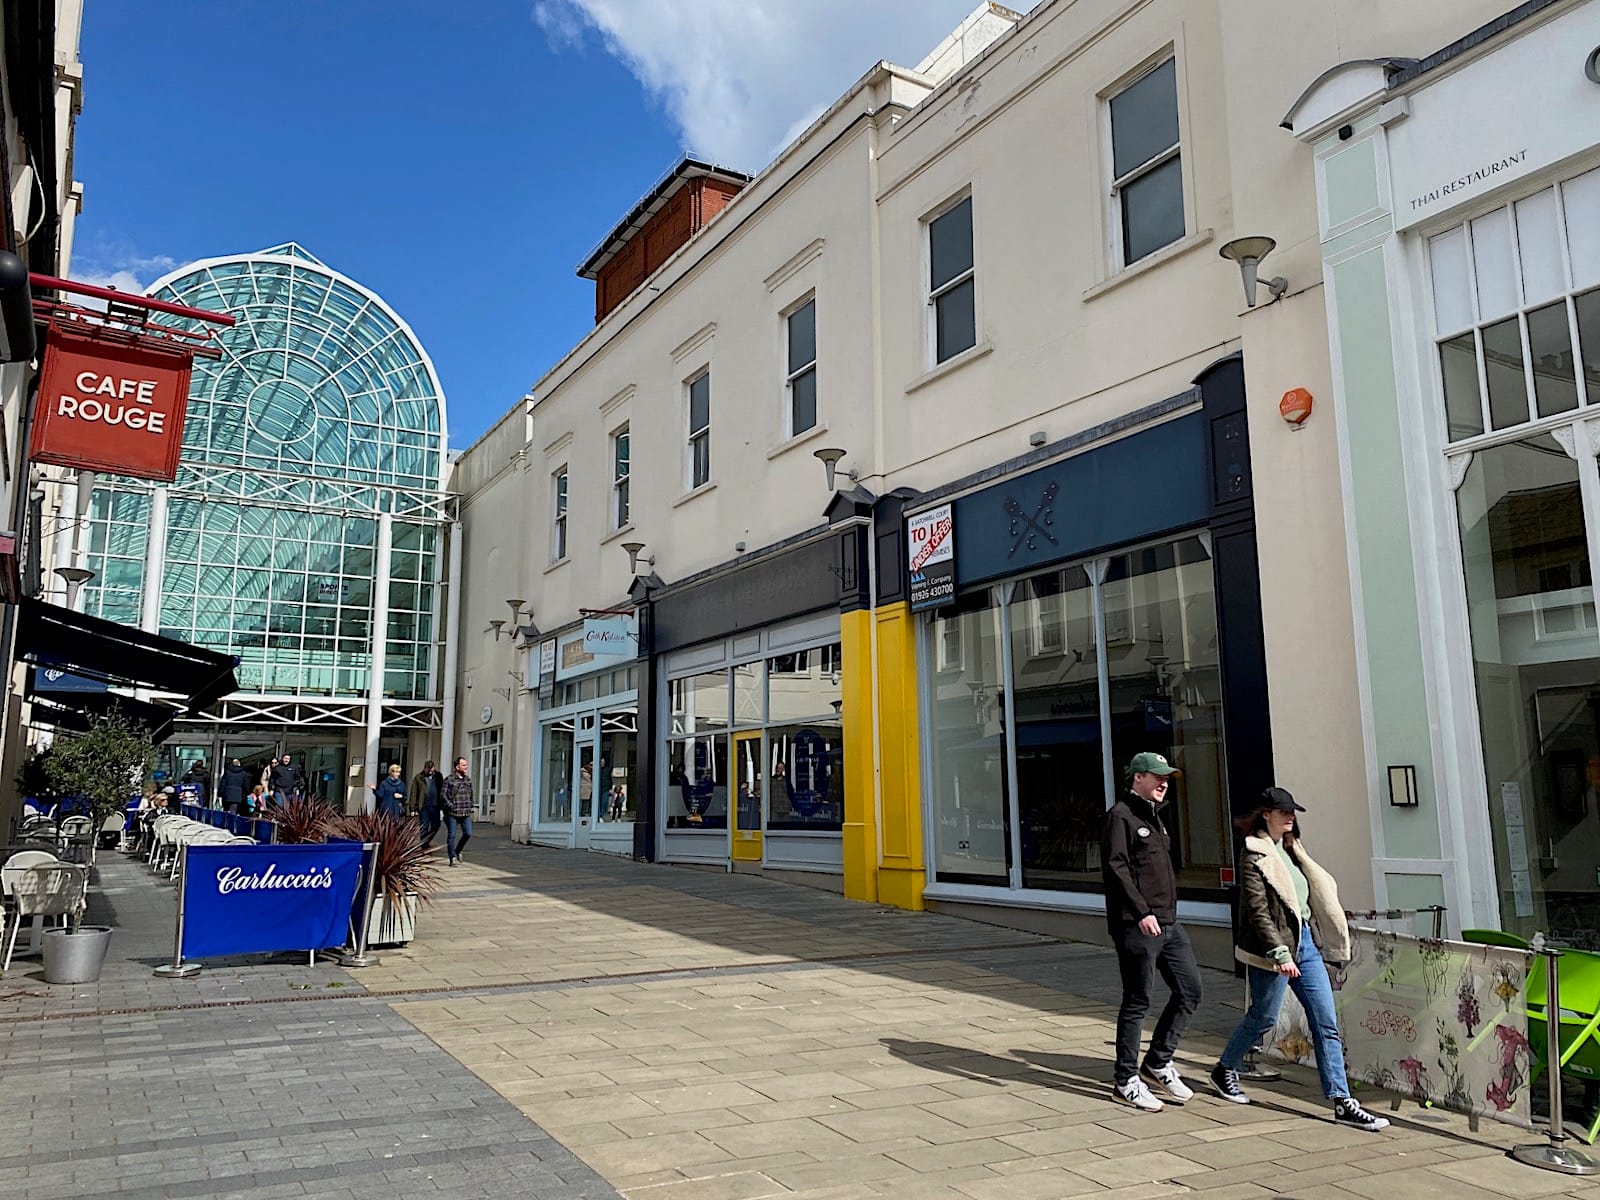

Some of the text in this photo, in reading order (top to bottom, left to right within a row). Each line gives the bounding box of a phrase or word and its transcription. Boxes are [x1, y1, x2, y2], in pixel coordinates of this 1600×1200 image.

[1410, 149, 1528, 210] THAI RESTAURANT
[58, 395, 166, 434] ROUGE
[911, 526, 926, 543] TO
[911, 518, 952, 571] UNDER OFFER
[320, 583, 349, 591] SPOS
[911, 589, 929, 602] 01926
[930, 583, 954, 596] 430700
[216, 863, 332, 894] Carluccio's
